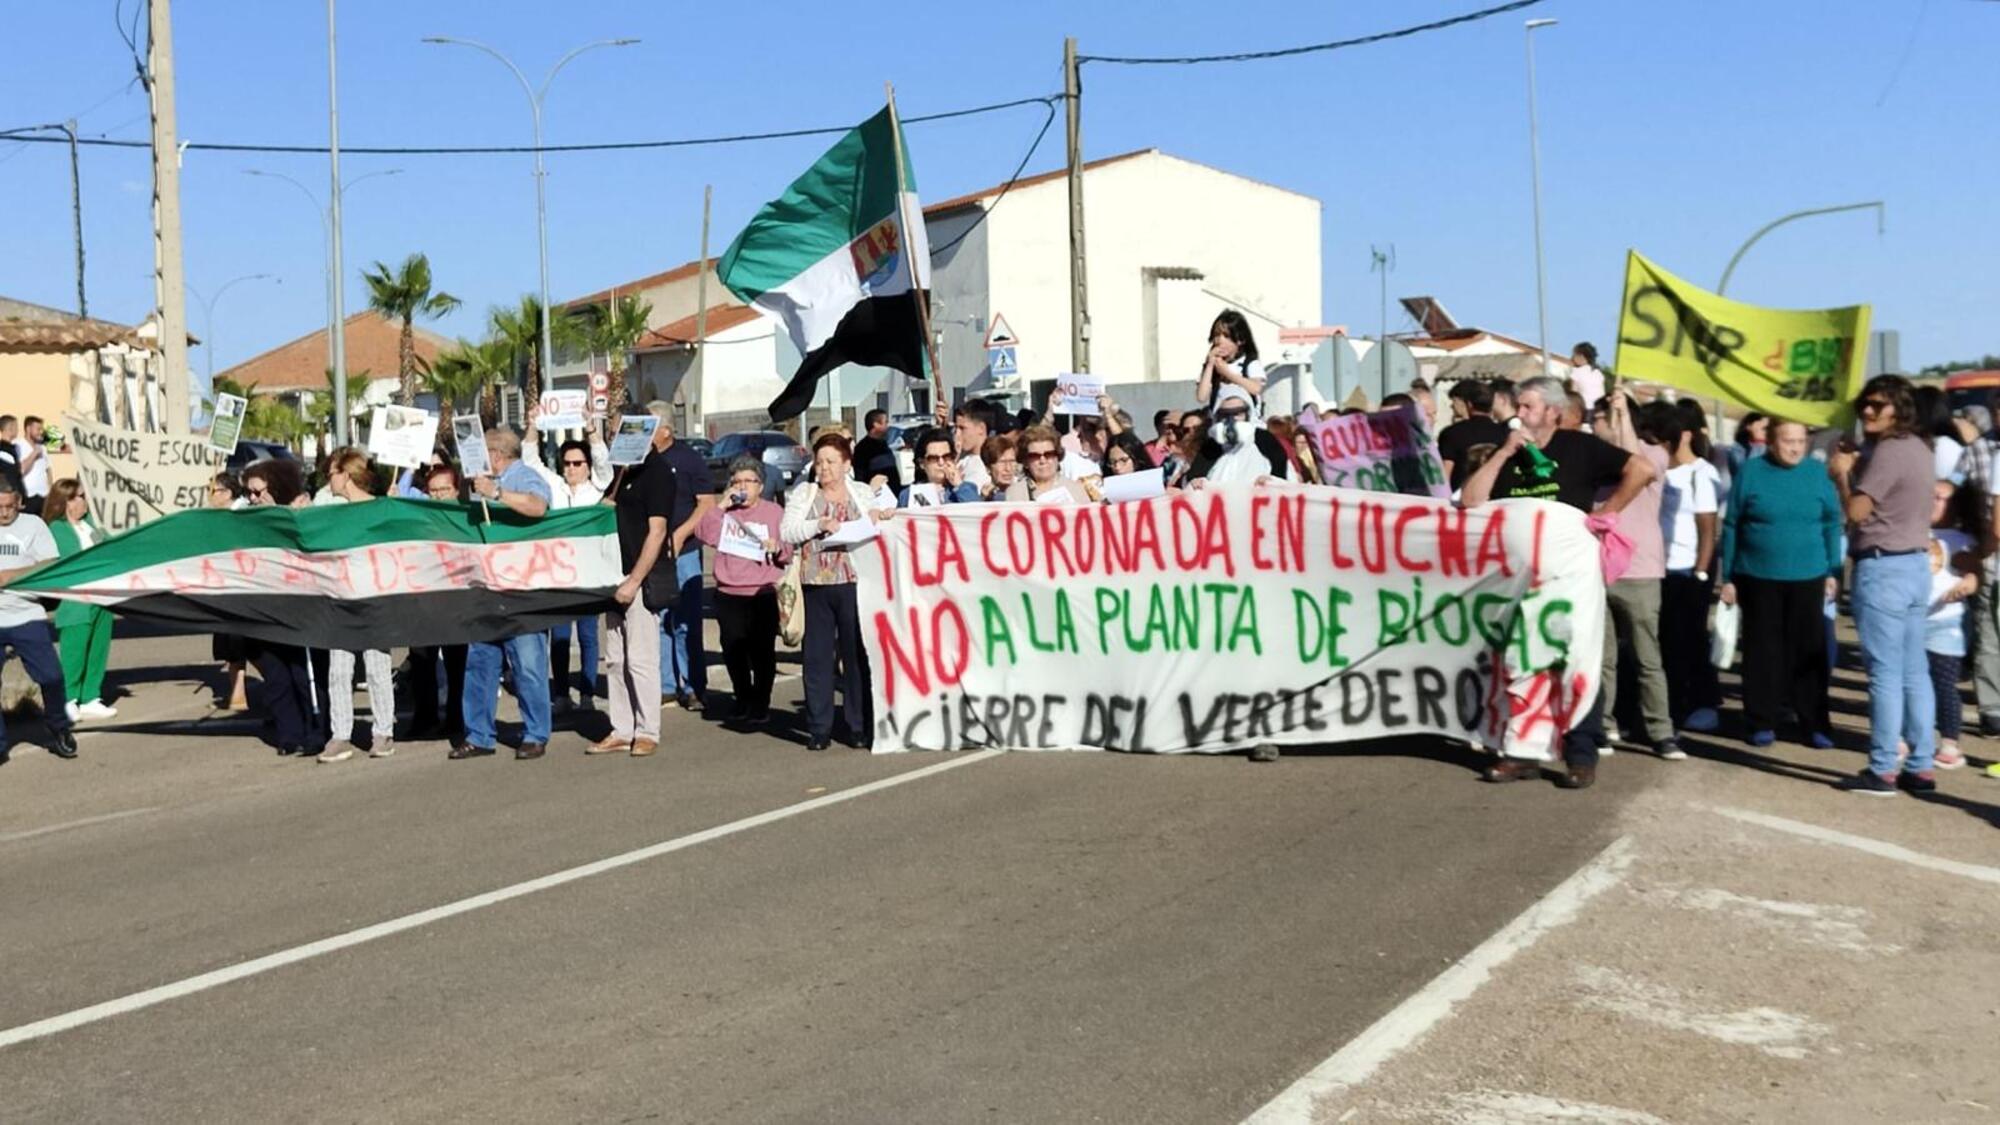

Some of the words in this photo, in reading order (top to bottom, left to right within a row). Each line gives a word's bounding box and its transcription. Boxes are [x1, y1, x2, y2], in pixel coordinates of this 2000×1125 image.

[981, 493, 1236, 580] CORONADA
[1251, 493, 1307, 574] EN
[874, 598, 971, 707] NO
[980, 595, 1018, 667] A
[1021, 587, 1080, 655] LA
[1095, 582, 1264, 656] PLANTA
[1291, 585, 1355, 668] DE
[1079, 691, 1148, 752] DEL
